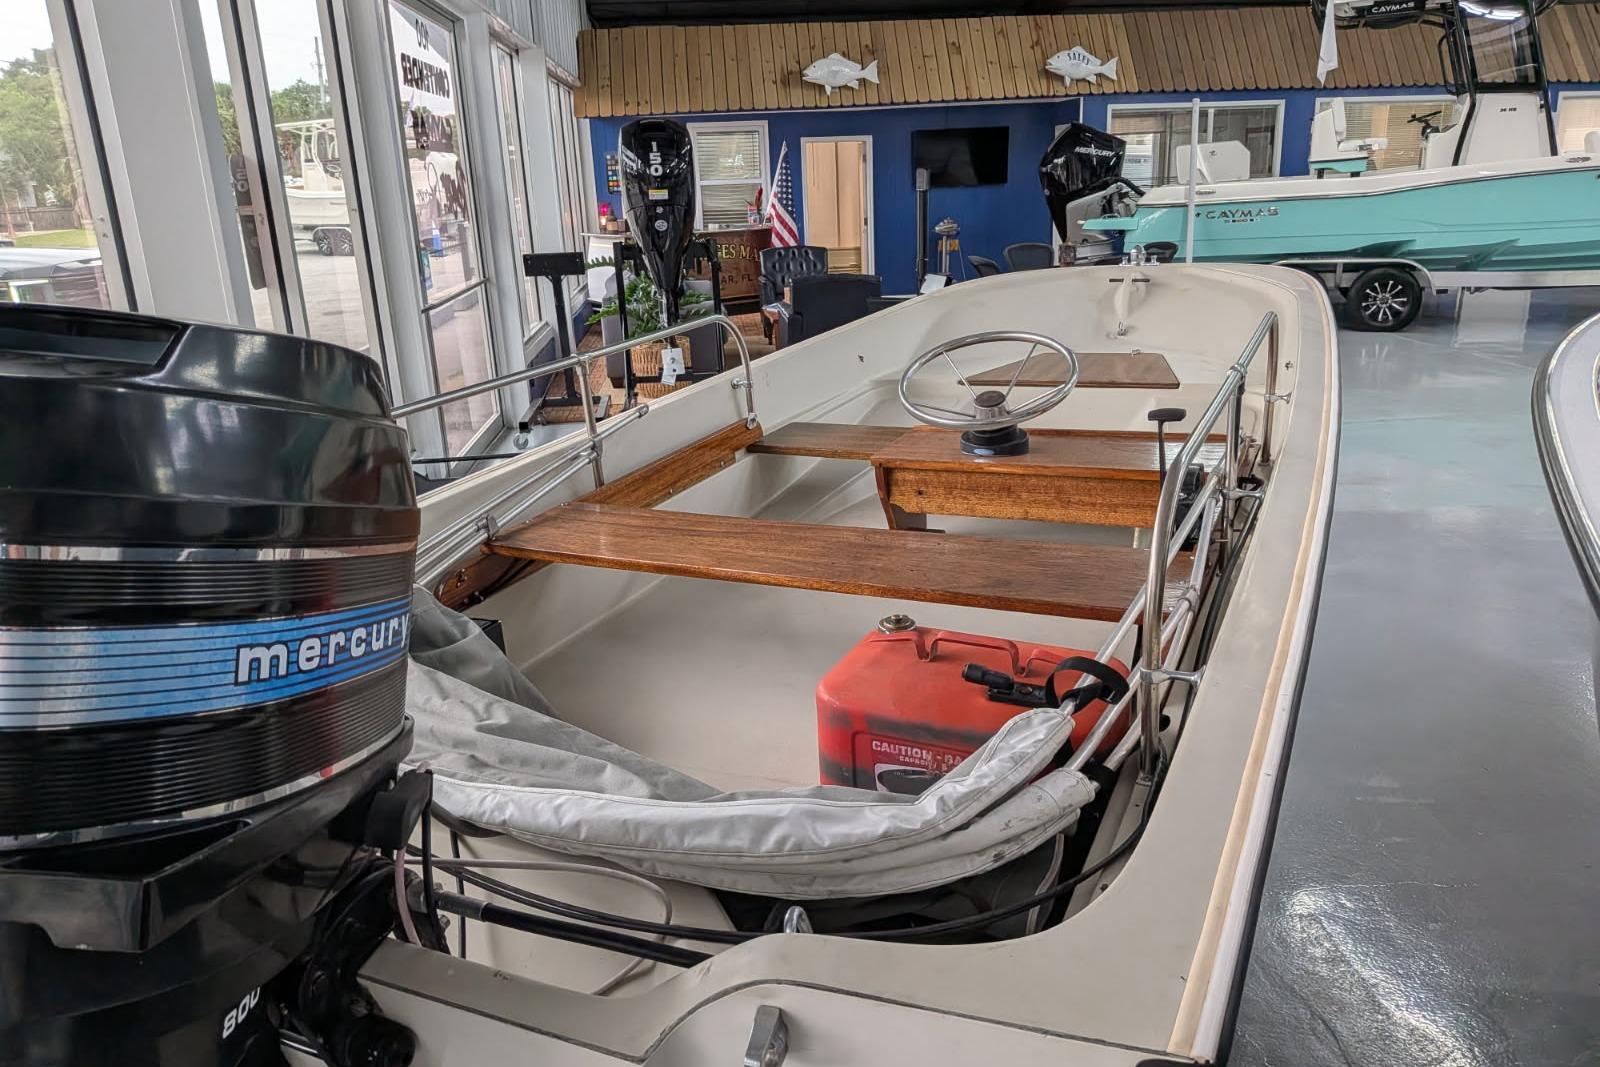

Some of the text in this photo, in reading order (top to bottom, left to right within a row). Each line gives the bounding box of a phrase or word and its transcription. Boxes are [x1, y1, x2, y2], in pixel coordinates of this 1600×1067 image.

[1371, 1, 1415, 13] CAYMAS
[649, 141, 663, 176] 150
[1074, 145, 1116, 157] MERCURY
[1205, 206, 1280, 219] CAYMAS
[235, 612, 410, 686] mercury
[872, 740, 933, 760] CAUTION
[222, 986, 261, 1040] 800
